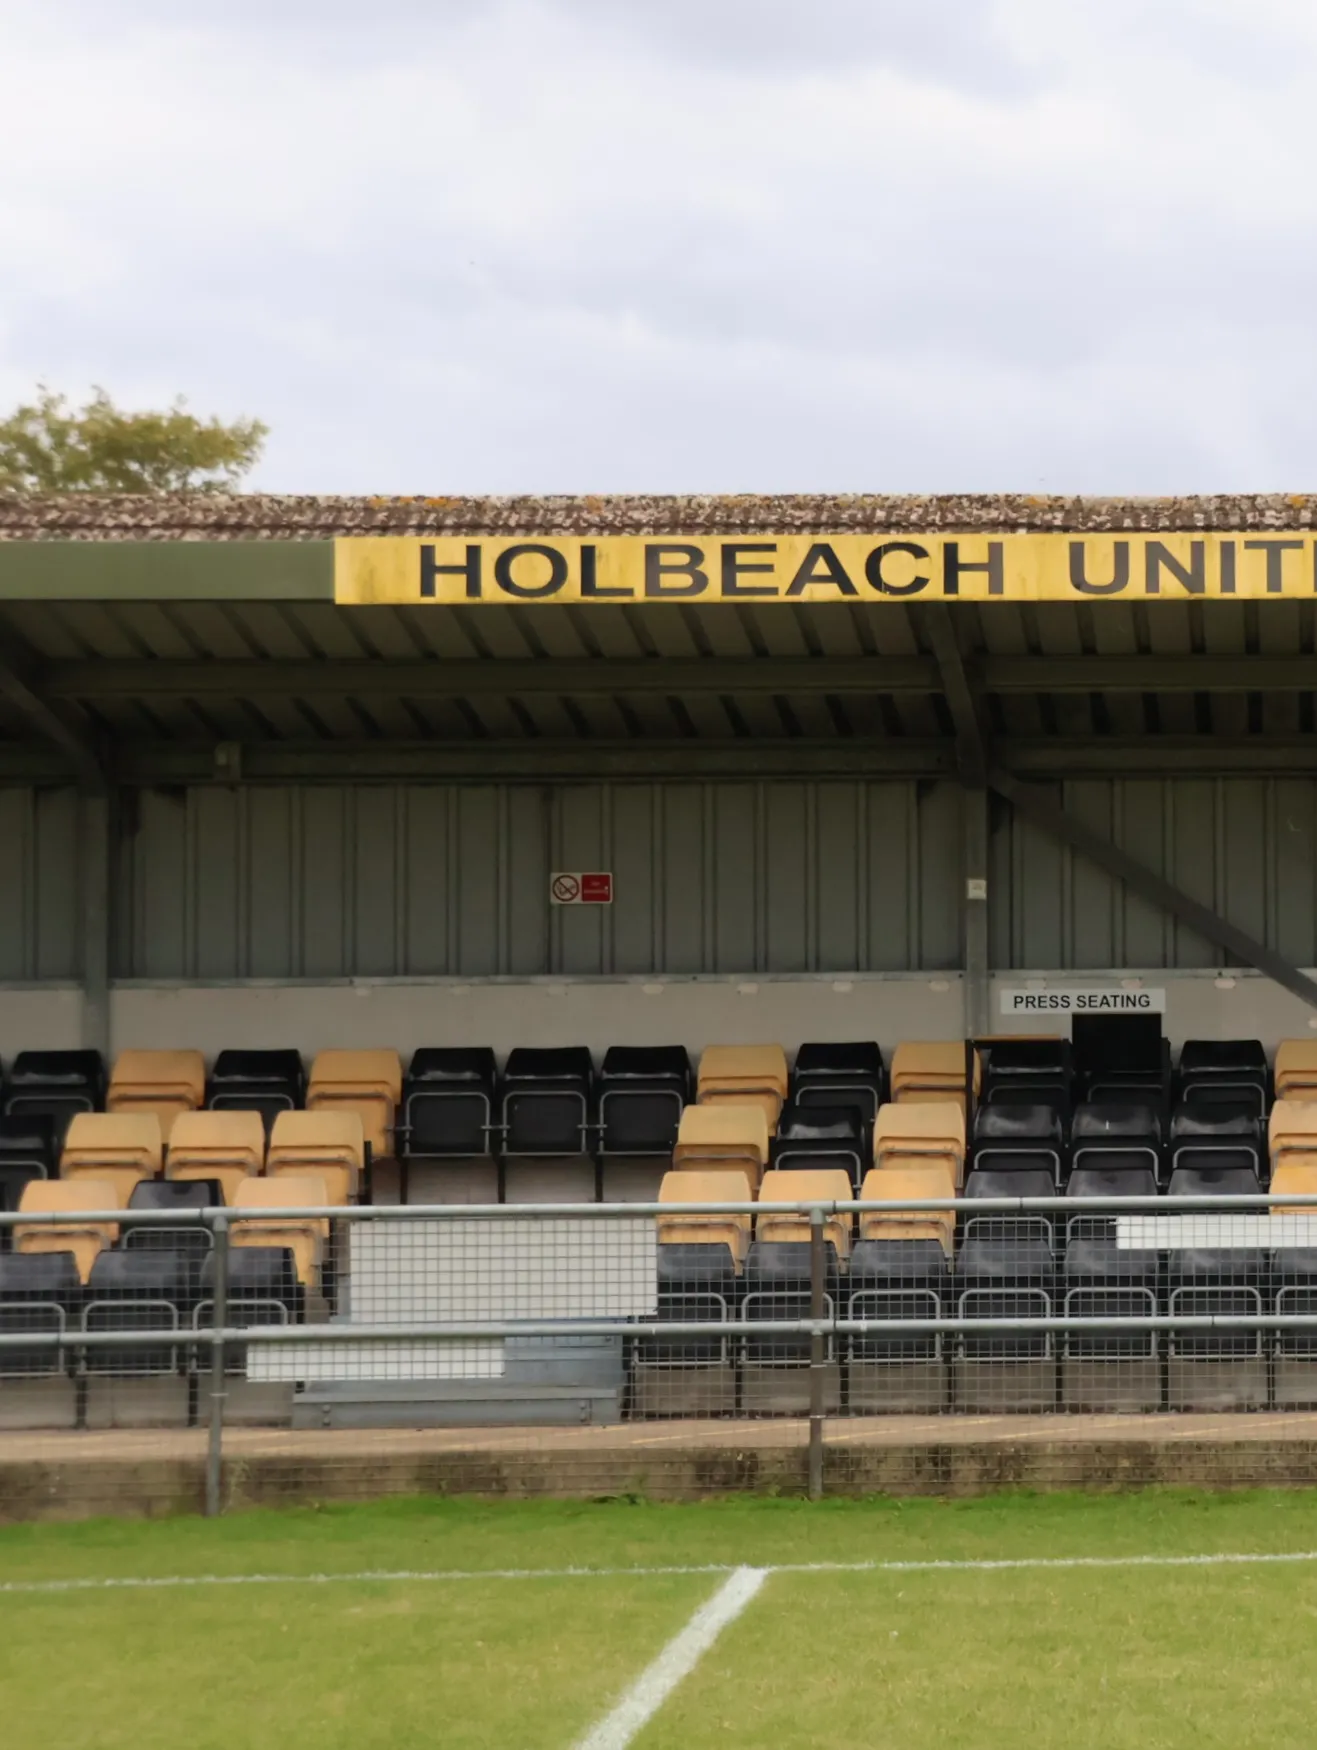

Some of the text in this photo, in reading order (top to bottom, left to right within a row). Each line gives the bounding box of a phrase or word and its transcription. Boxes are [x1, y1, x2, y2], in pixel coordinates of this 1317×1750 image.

[420, 541, 1003, 598] HOLBEACH
[1014, 994, 1150, 1008] PRESS SEATING
